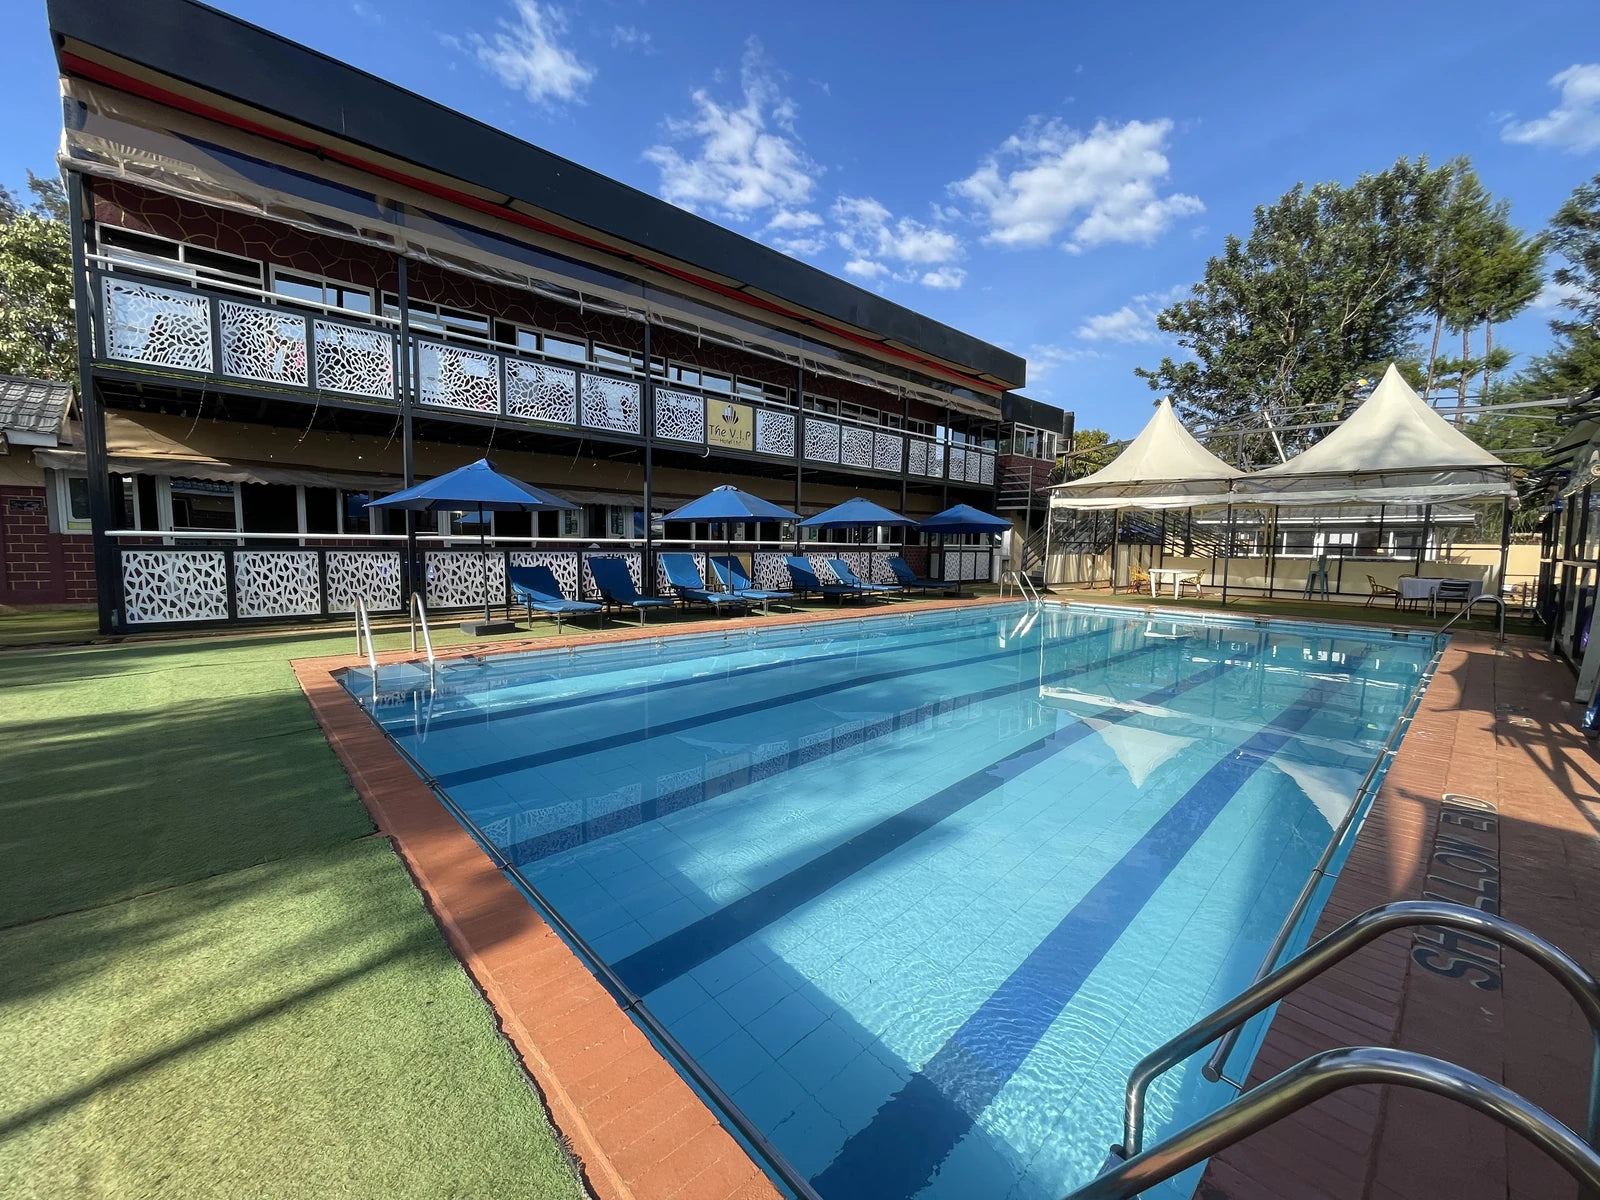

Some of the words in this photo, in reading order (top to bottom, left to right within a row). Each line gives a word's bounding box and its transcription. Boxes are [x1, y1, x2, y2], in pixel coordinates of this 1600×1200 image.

[709, 425, 726, 437] The
[729, 428, 751, 440] V.I.P
[1440, 794, 1498, 832] END
[1411, 833, 1503, 991] SHLLOW
